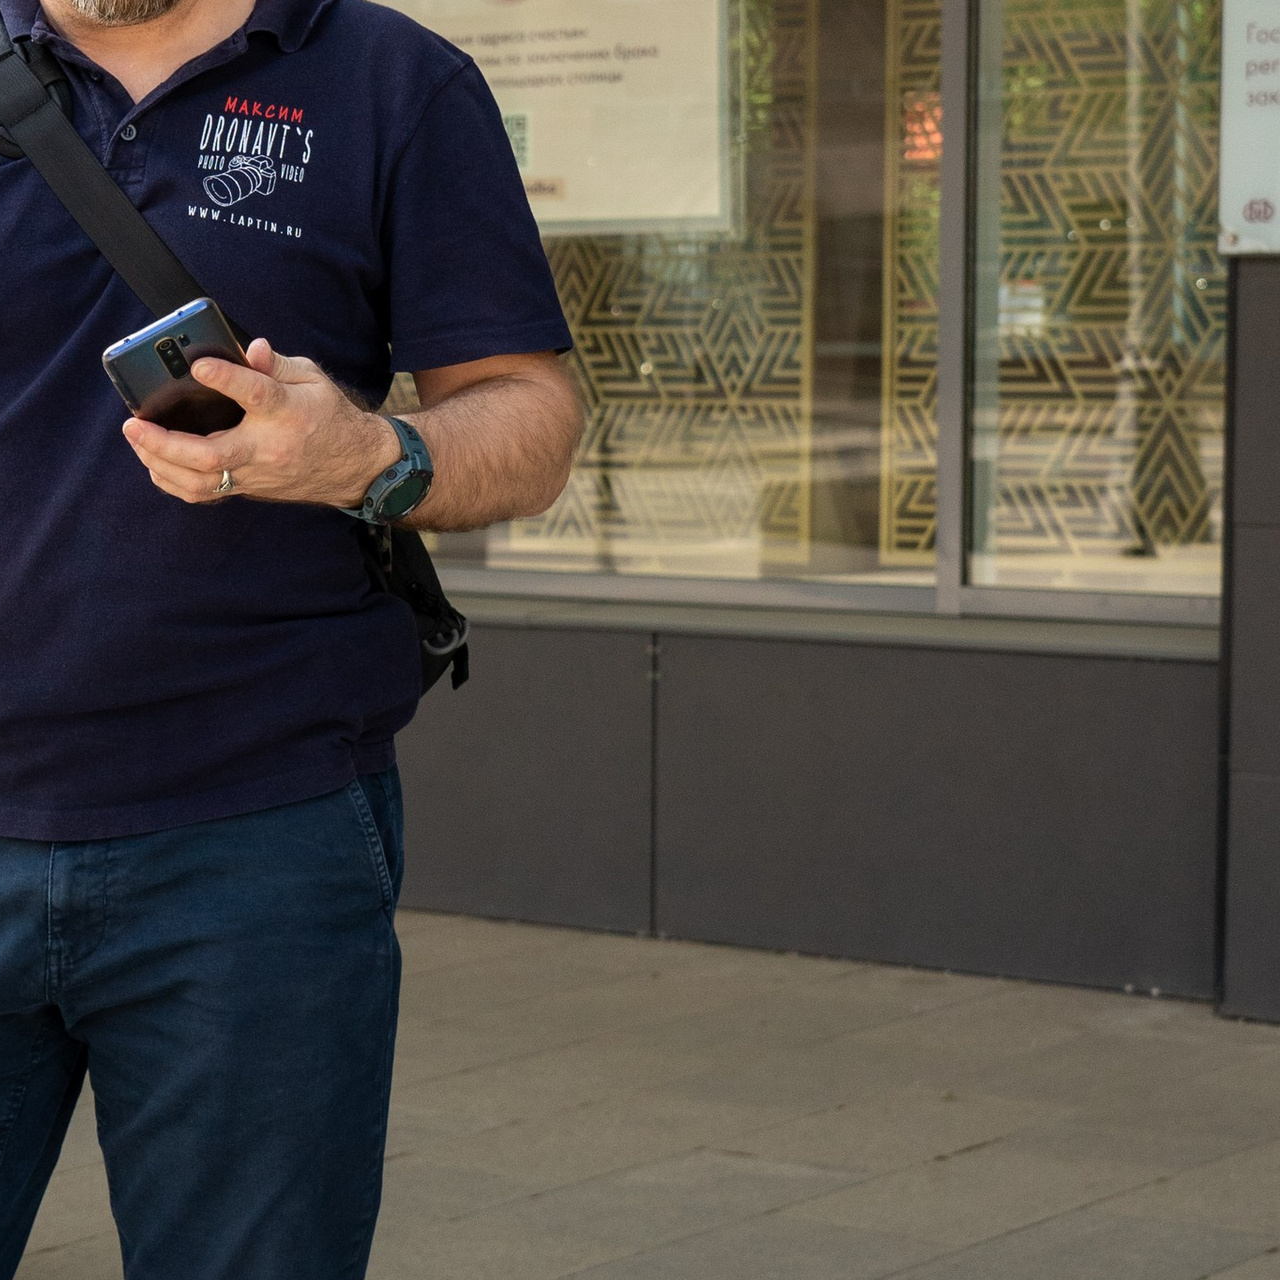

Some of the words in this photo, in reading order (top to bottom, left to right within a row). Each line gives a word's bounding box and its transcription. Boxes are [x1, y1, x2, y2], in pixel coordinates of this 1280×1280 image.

[224, 96, 304, 123] МАКСИМ
[197, 154, 226, 171] PHOTO
[280, 163, 305, 183] VIDEO
[188, 205, 302, 238] WWW.LAPTIN.RU
